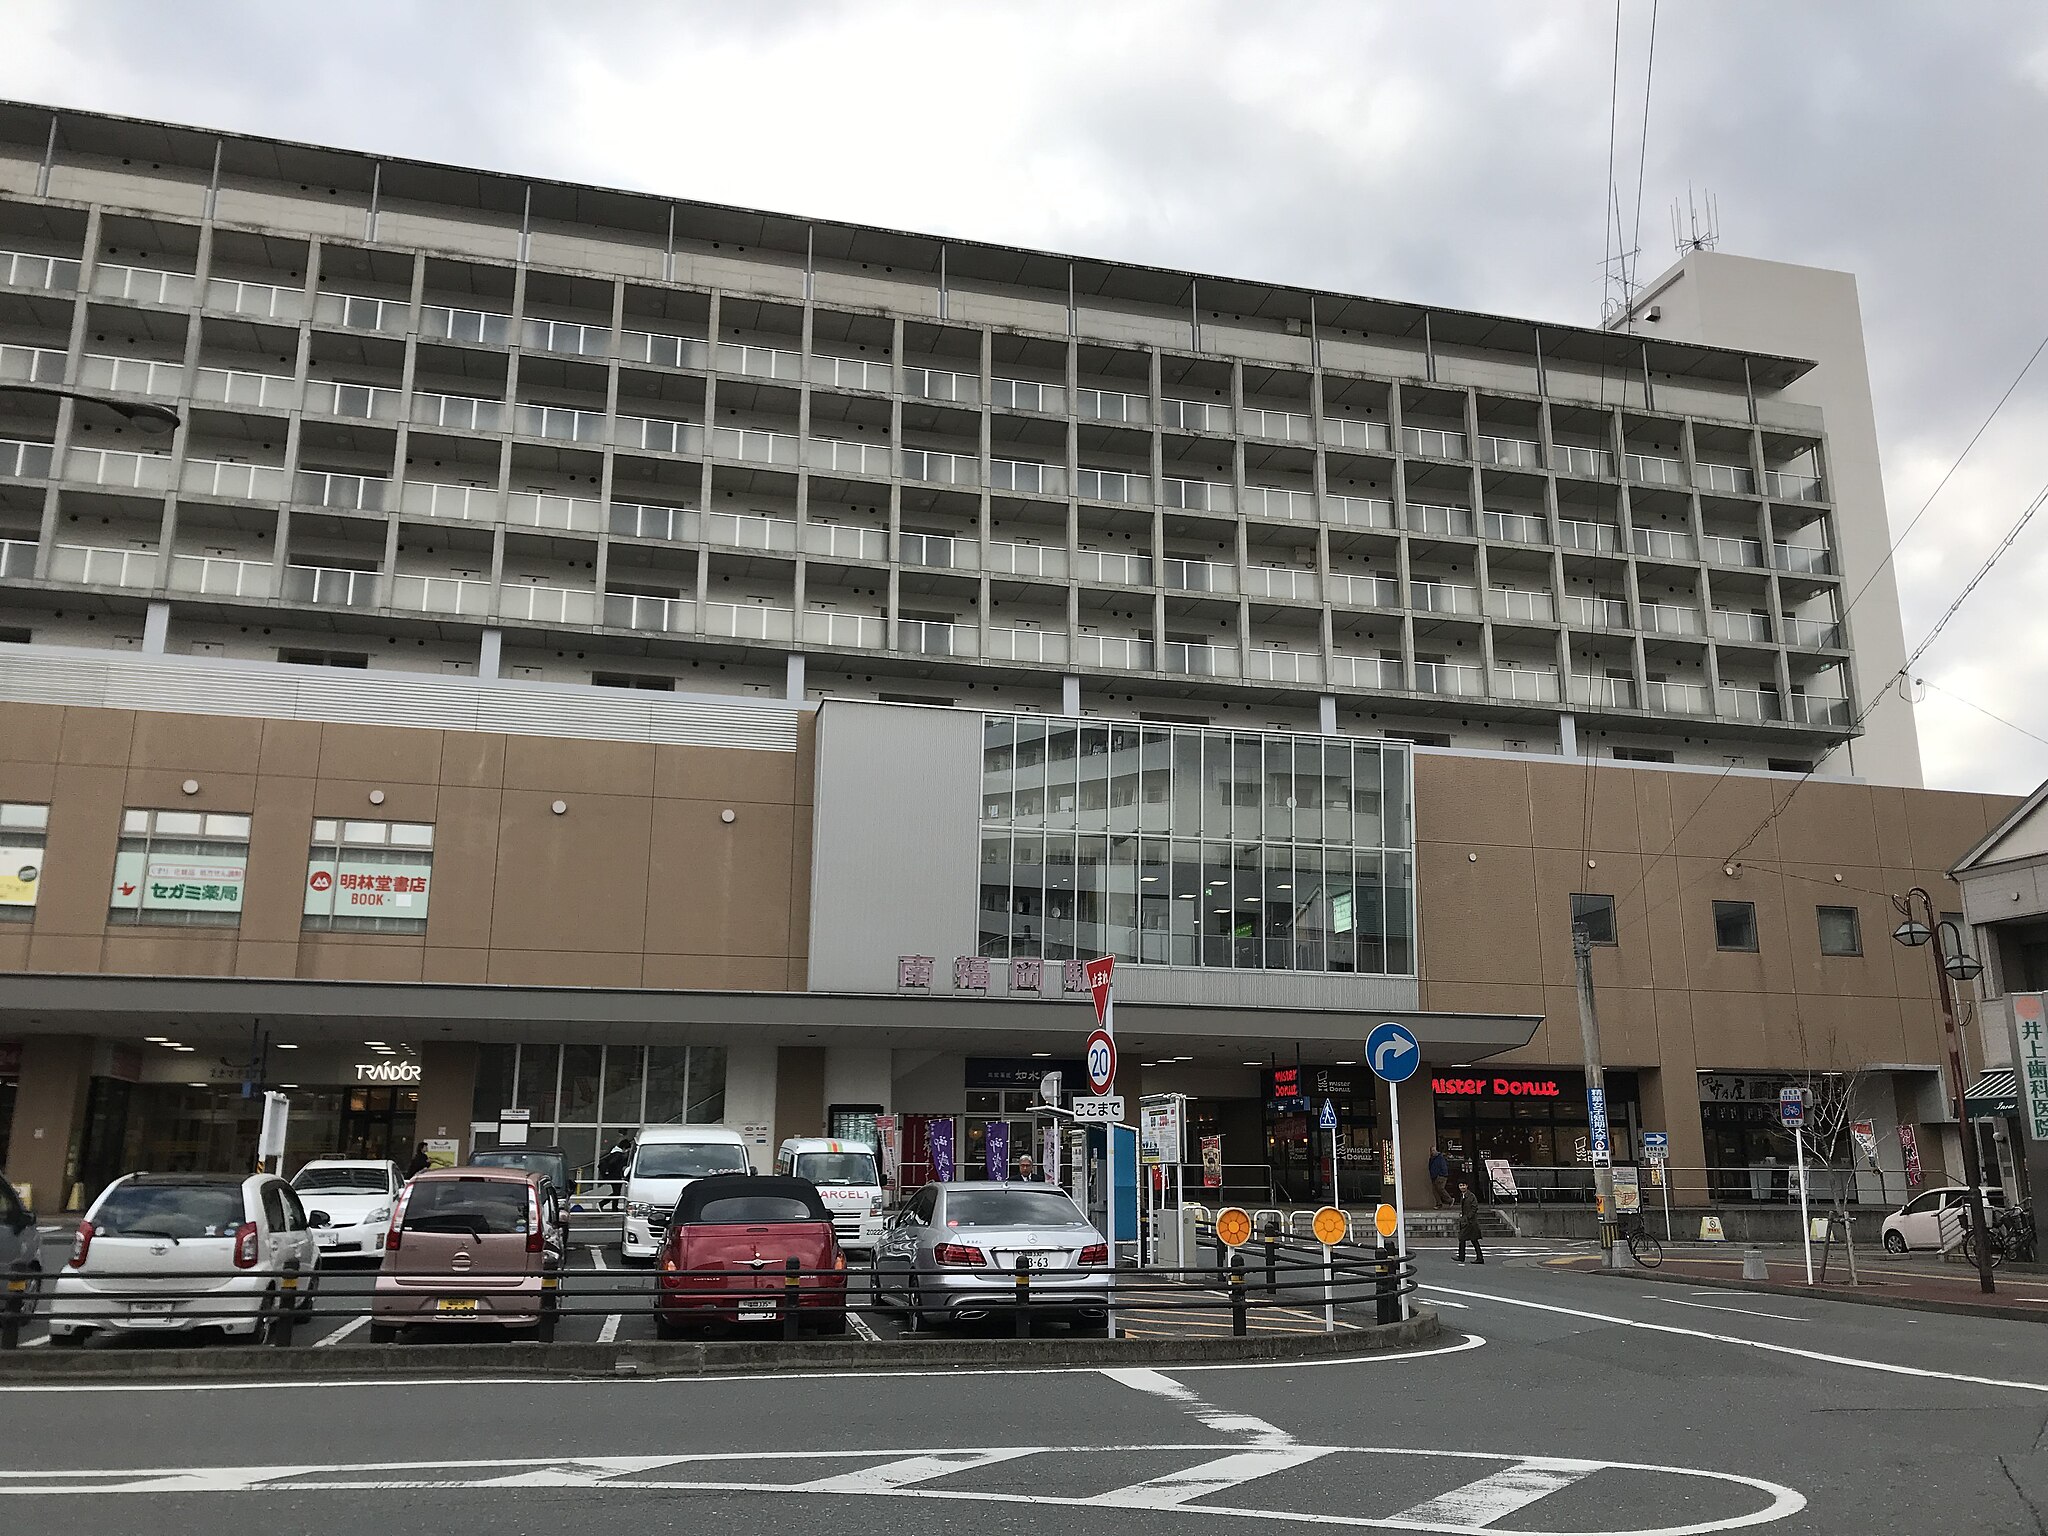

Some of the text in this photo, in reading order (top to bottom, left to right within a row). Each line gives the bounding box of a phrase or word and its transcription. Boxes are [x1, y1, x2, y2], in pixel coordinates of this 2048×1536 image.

[151, 882, 238, 901] セガミ薬局
[340, 874, 426, 892] 明林堂書店
[351, 893, 384, 905] BOOK
[1092, 969, 1109, 988] 止まれ
[1090, 1048, 1108, 1077] 20
[1493, 1078, 1559, 1096] Donut
[1075, 1102, 1120, 1117] ここまで
[820, 1190, 869, 1199] ARCEL1
